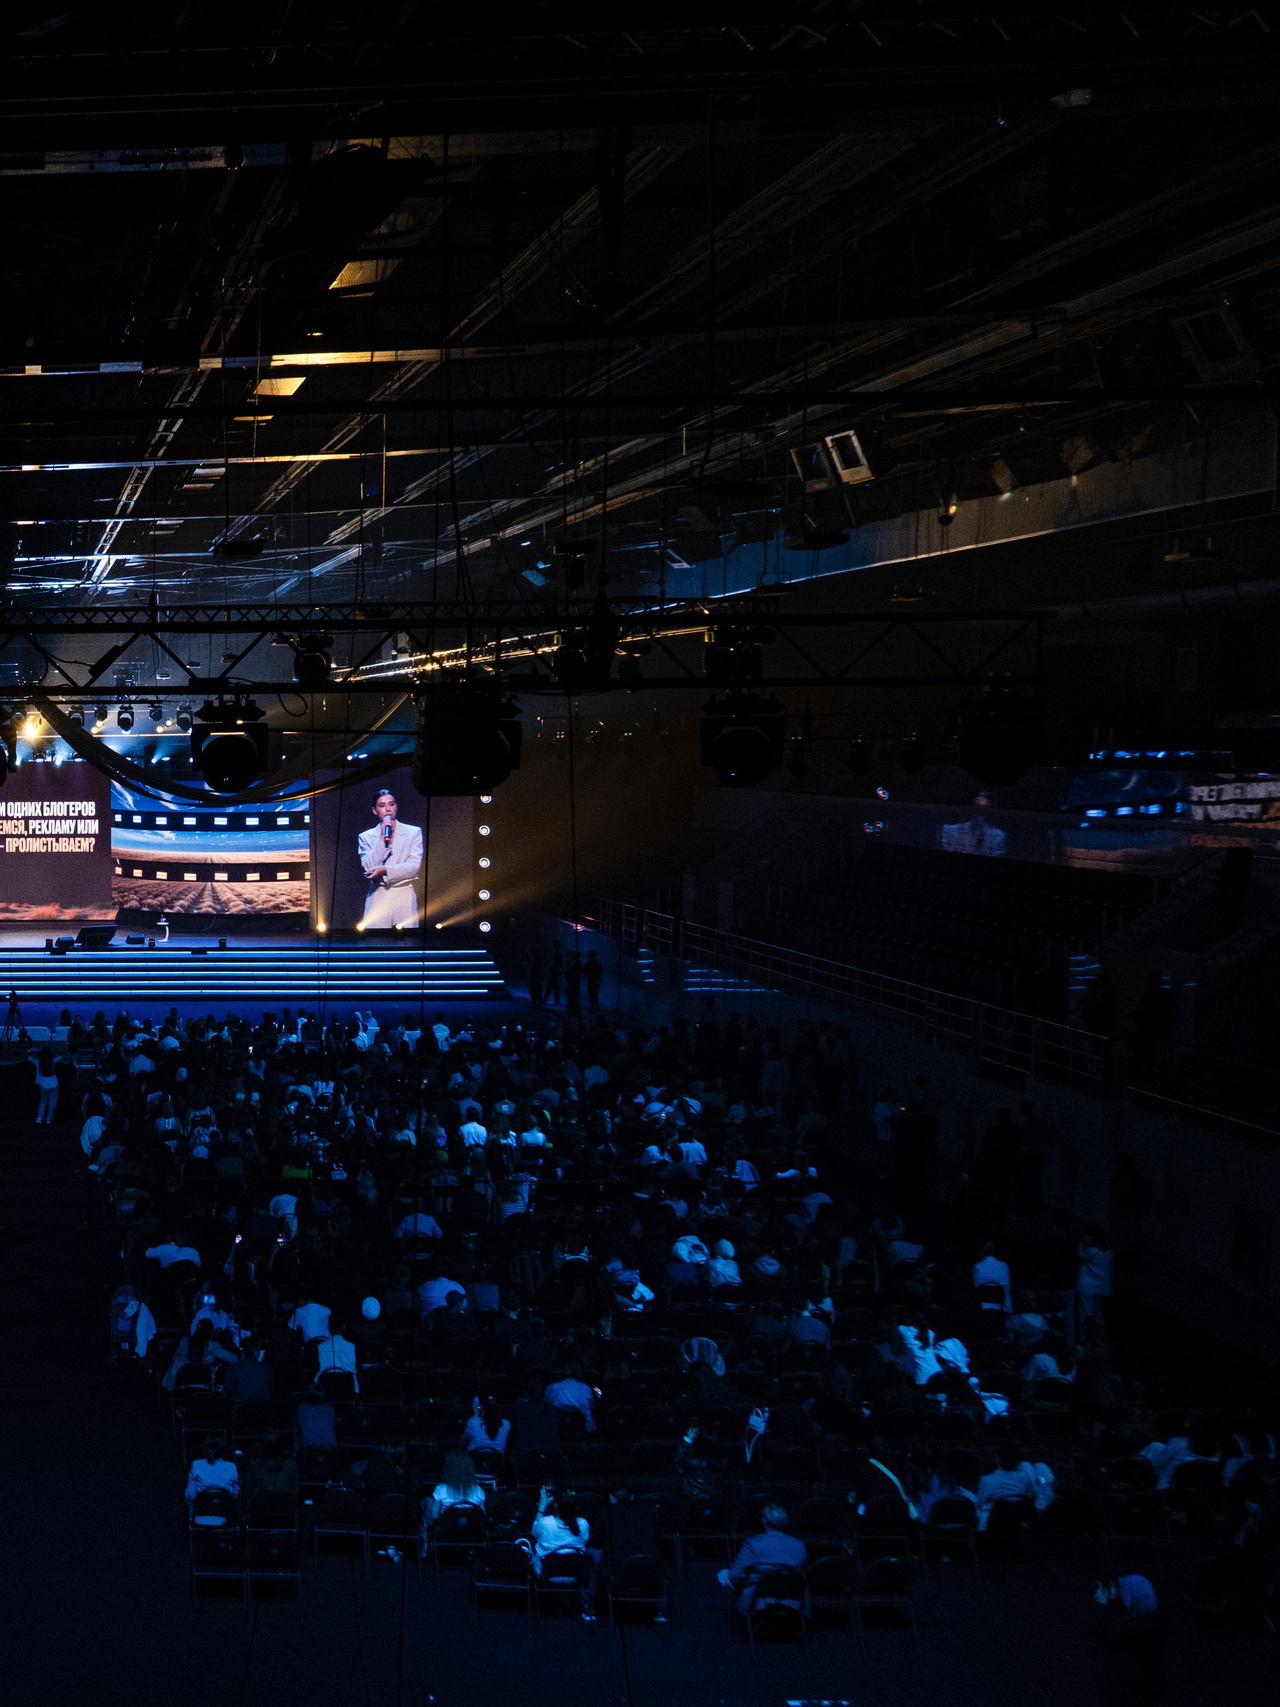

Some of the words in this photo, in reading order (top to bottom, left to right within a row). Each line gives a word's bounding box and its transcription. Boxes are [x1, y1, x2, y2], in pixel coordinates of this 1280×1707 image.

[7, 802, 42, 818] ОДНИХ
[43, 801, 96, 817] БЛОГЕРОВ
[29, 819, 76, 835] РЕКЛАМУ
[77, 819, 99, 835] ИЛИ
[5, 837, 96, 853] ПРОЛИСТЫВАЕМ?
